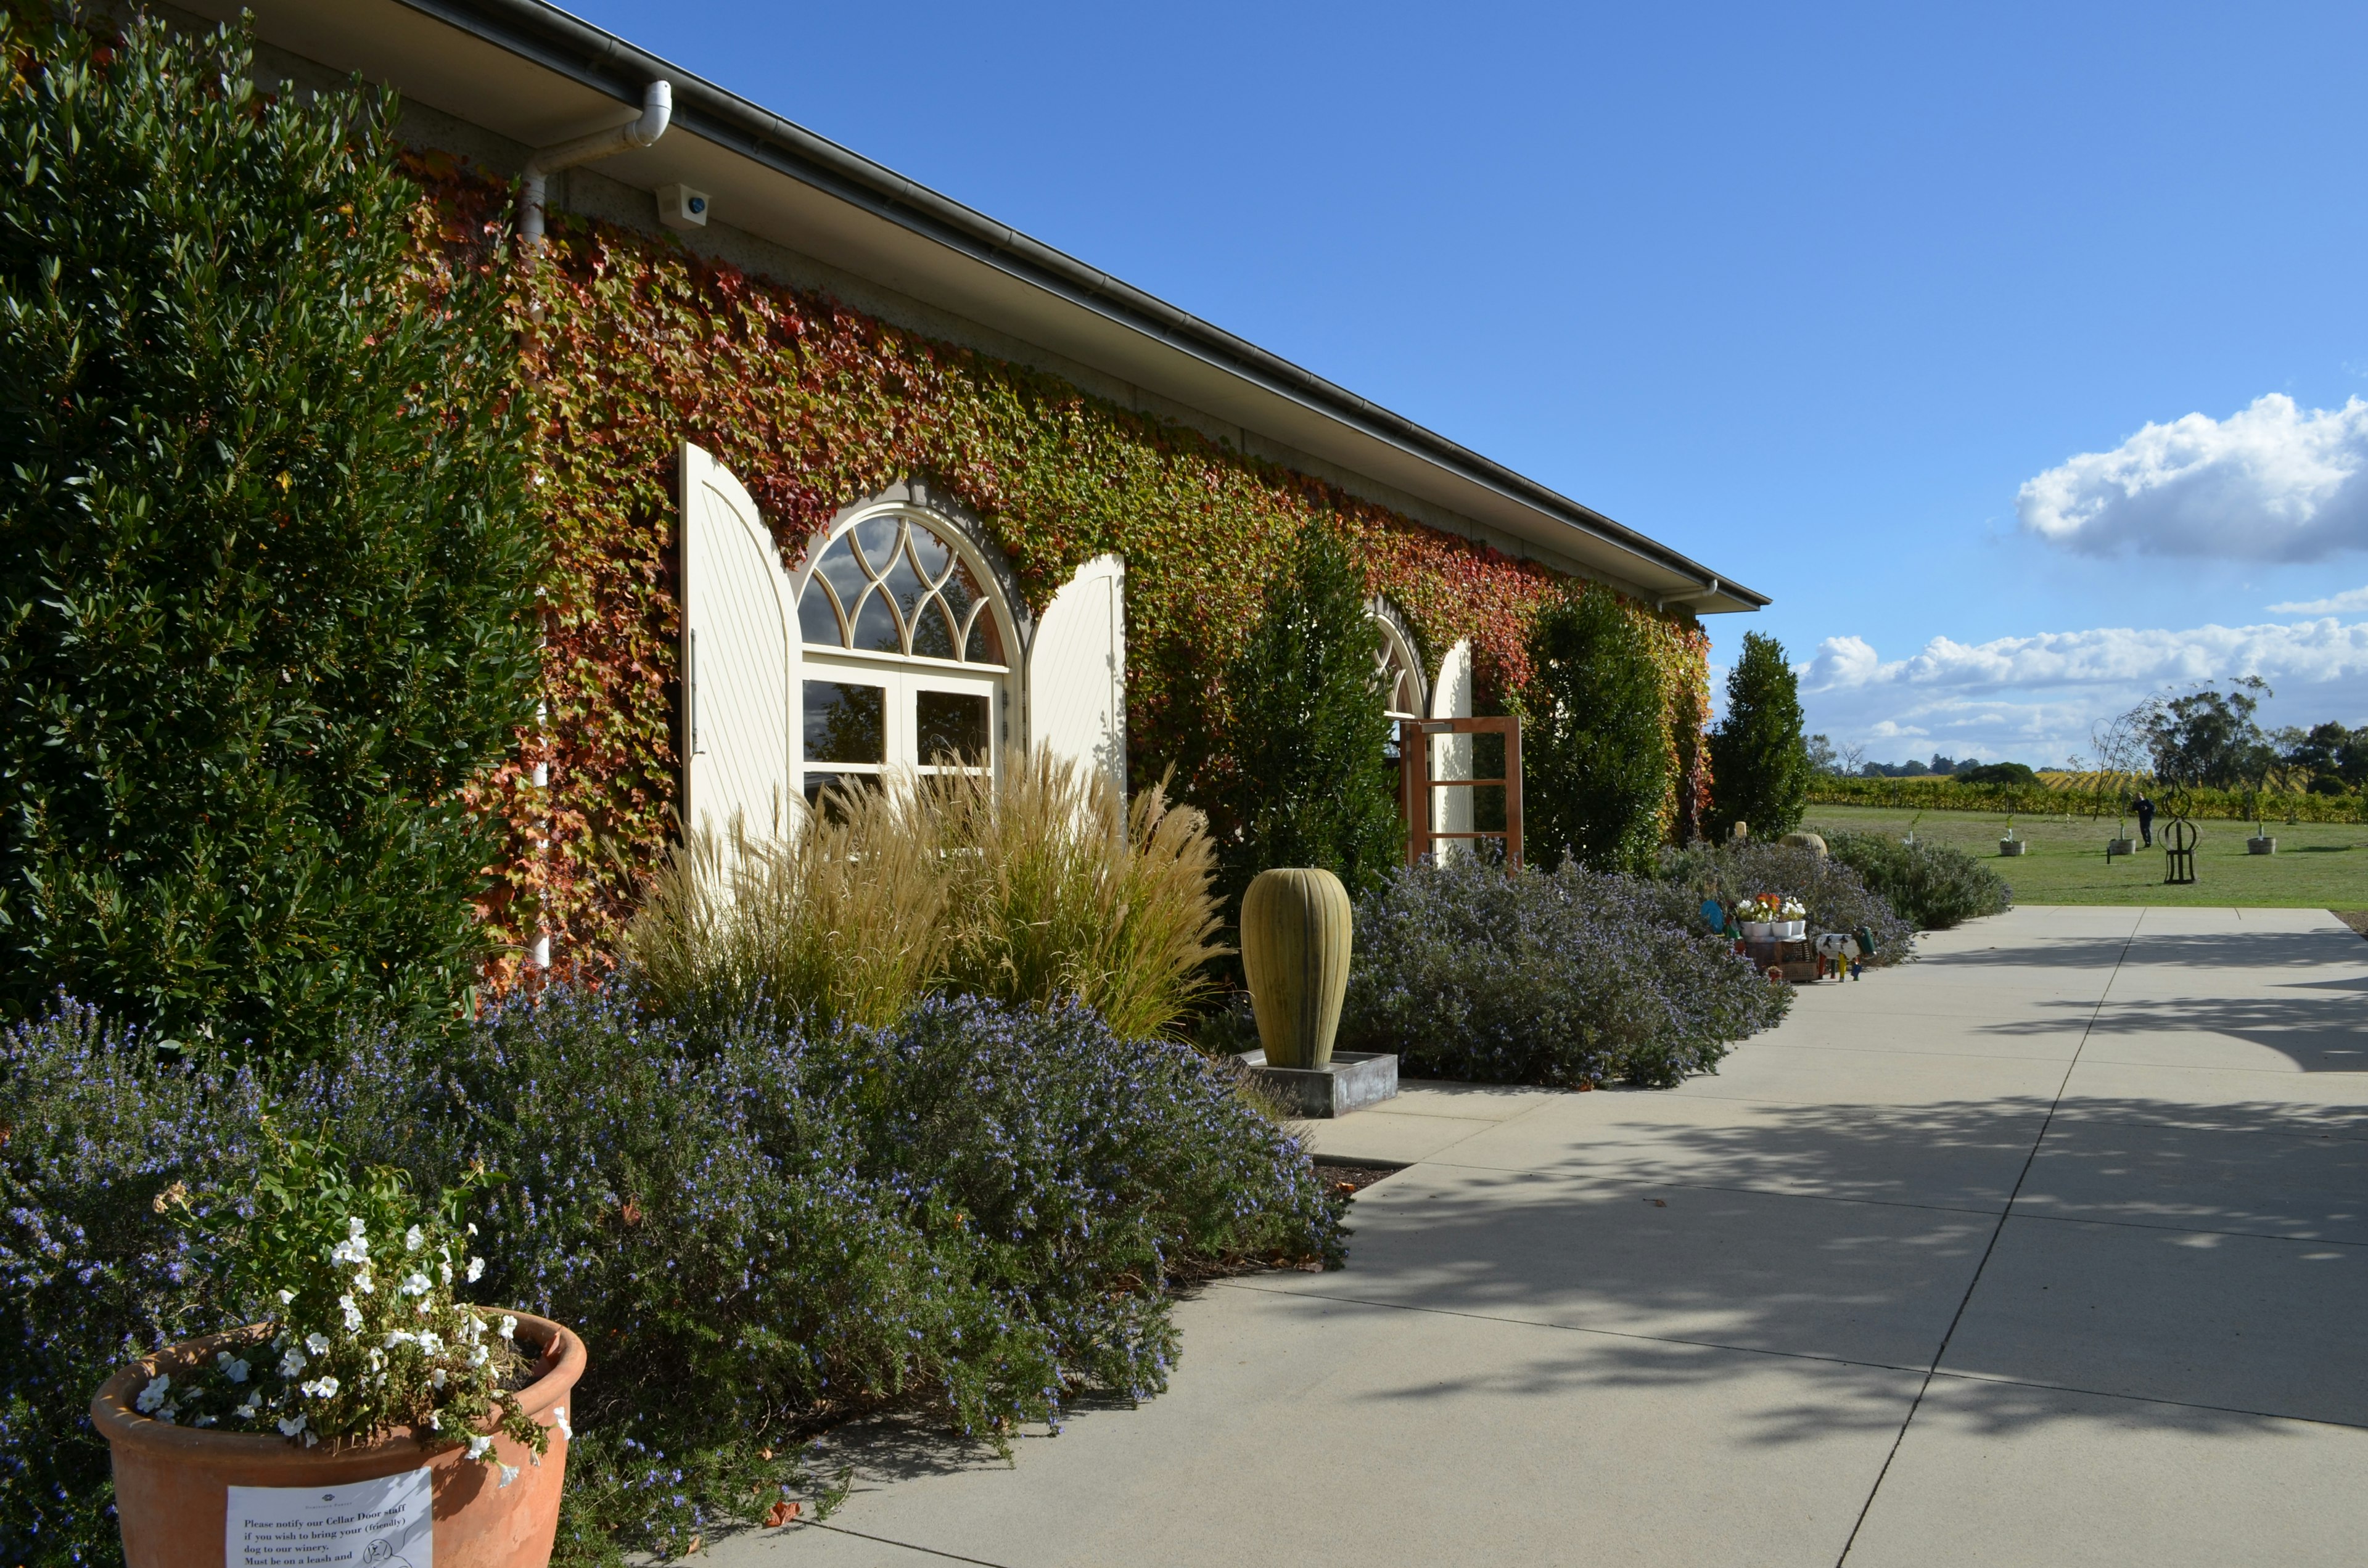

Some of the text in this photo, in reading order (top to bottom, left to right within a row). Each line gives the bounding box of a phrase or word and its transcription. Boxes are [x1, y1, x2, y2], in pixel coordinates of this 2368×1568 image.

[244, 1519, 273, 1528] Please
[276, 1520, 303, 1530] notify
[326, 1516, 355, 1525] Cellar
[358, 1512, 381, 1521] Door
[384, 1503, 406, 1516] staff
[244, 1532, 252, 1540] if
[255, 1535, 272, 1543] you
[275, 1532, 296, 1540] wish
[311, 1530, 337, 1540] bring
[340, 1527, 362, 1538] your
[365, 1517, 406, 1533] (friendly)
[244, 1545, 261, 1555] dog
[295, 1544, 329, 1553] winery.
[245, 1557, 268, 1565] Must
[271, 1557, 281, 1565] be
[307, 1554, 331, 1564] leash
[335, 1551, 352, 1561] and
